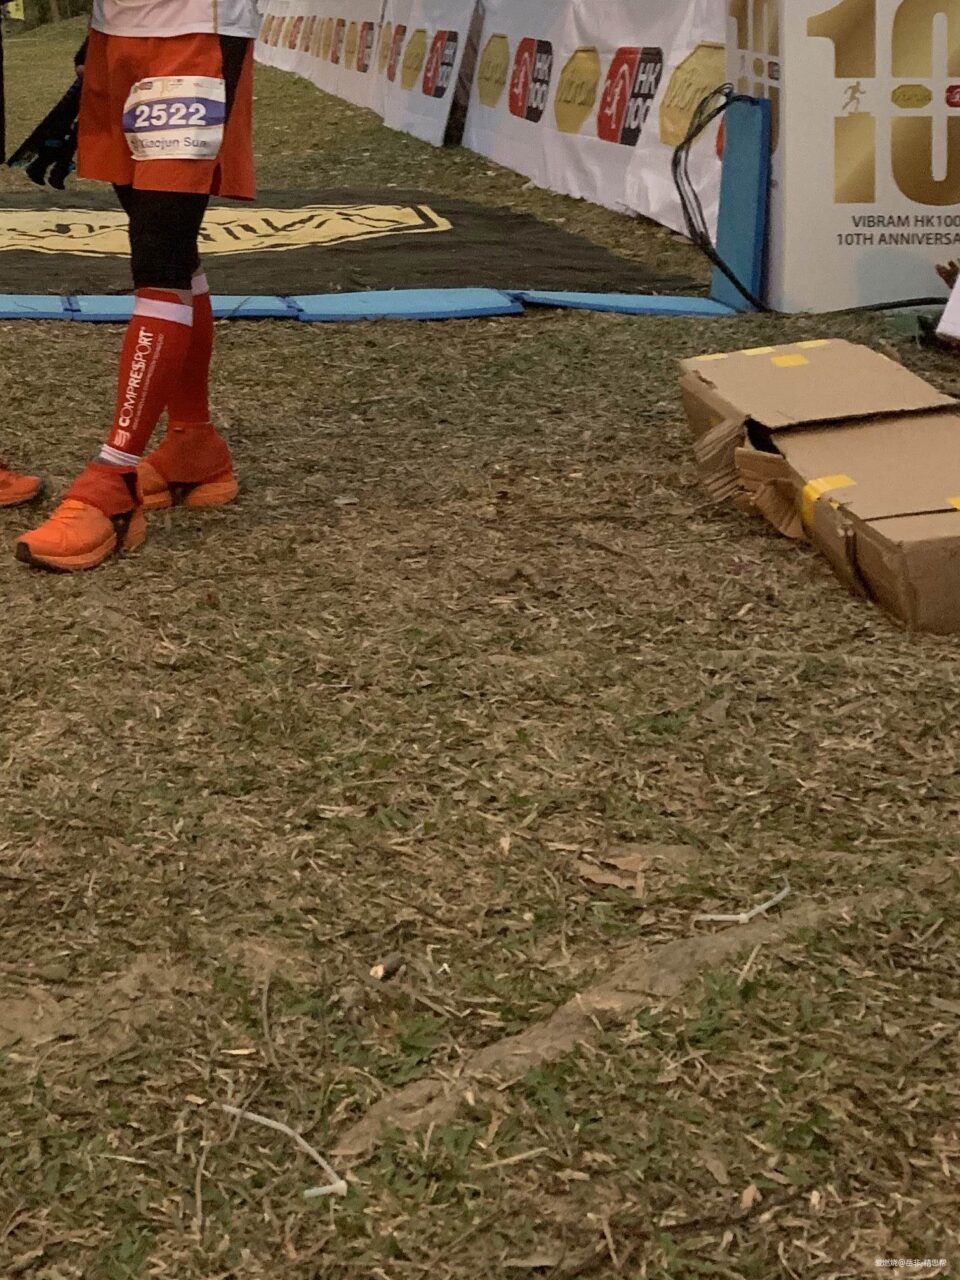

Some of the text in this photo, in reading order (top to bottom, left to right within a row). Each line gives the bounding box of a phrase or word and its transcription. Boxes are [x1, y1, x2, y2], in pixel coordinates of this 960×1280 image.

[634, 63, 661, 94] HK
[134, 102, 207, 128] 2522
[851, 215, 960, 229] VIBRAM HK100
[837, 232, 960, 247] 10TH ANNIVERSA
